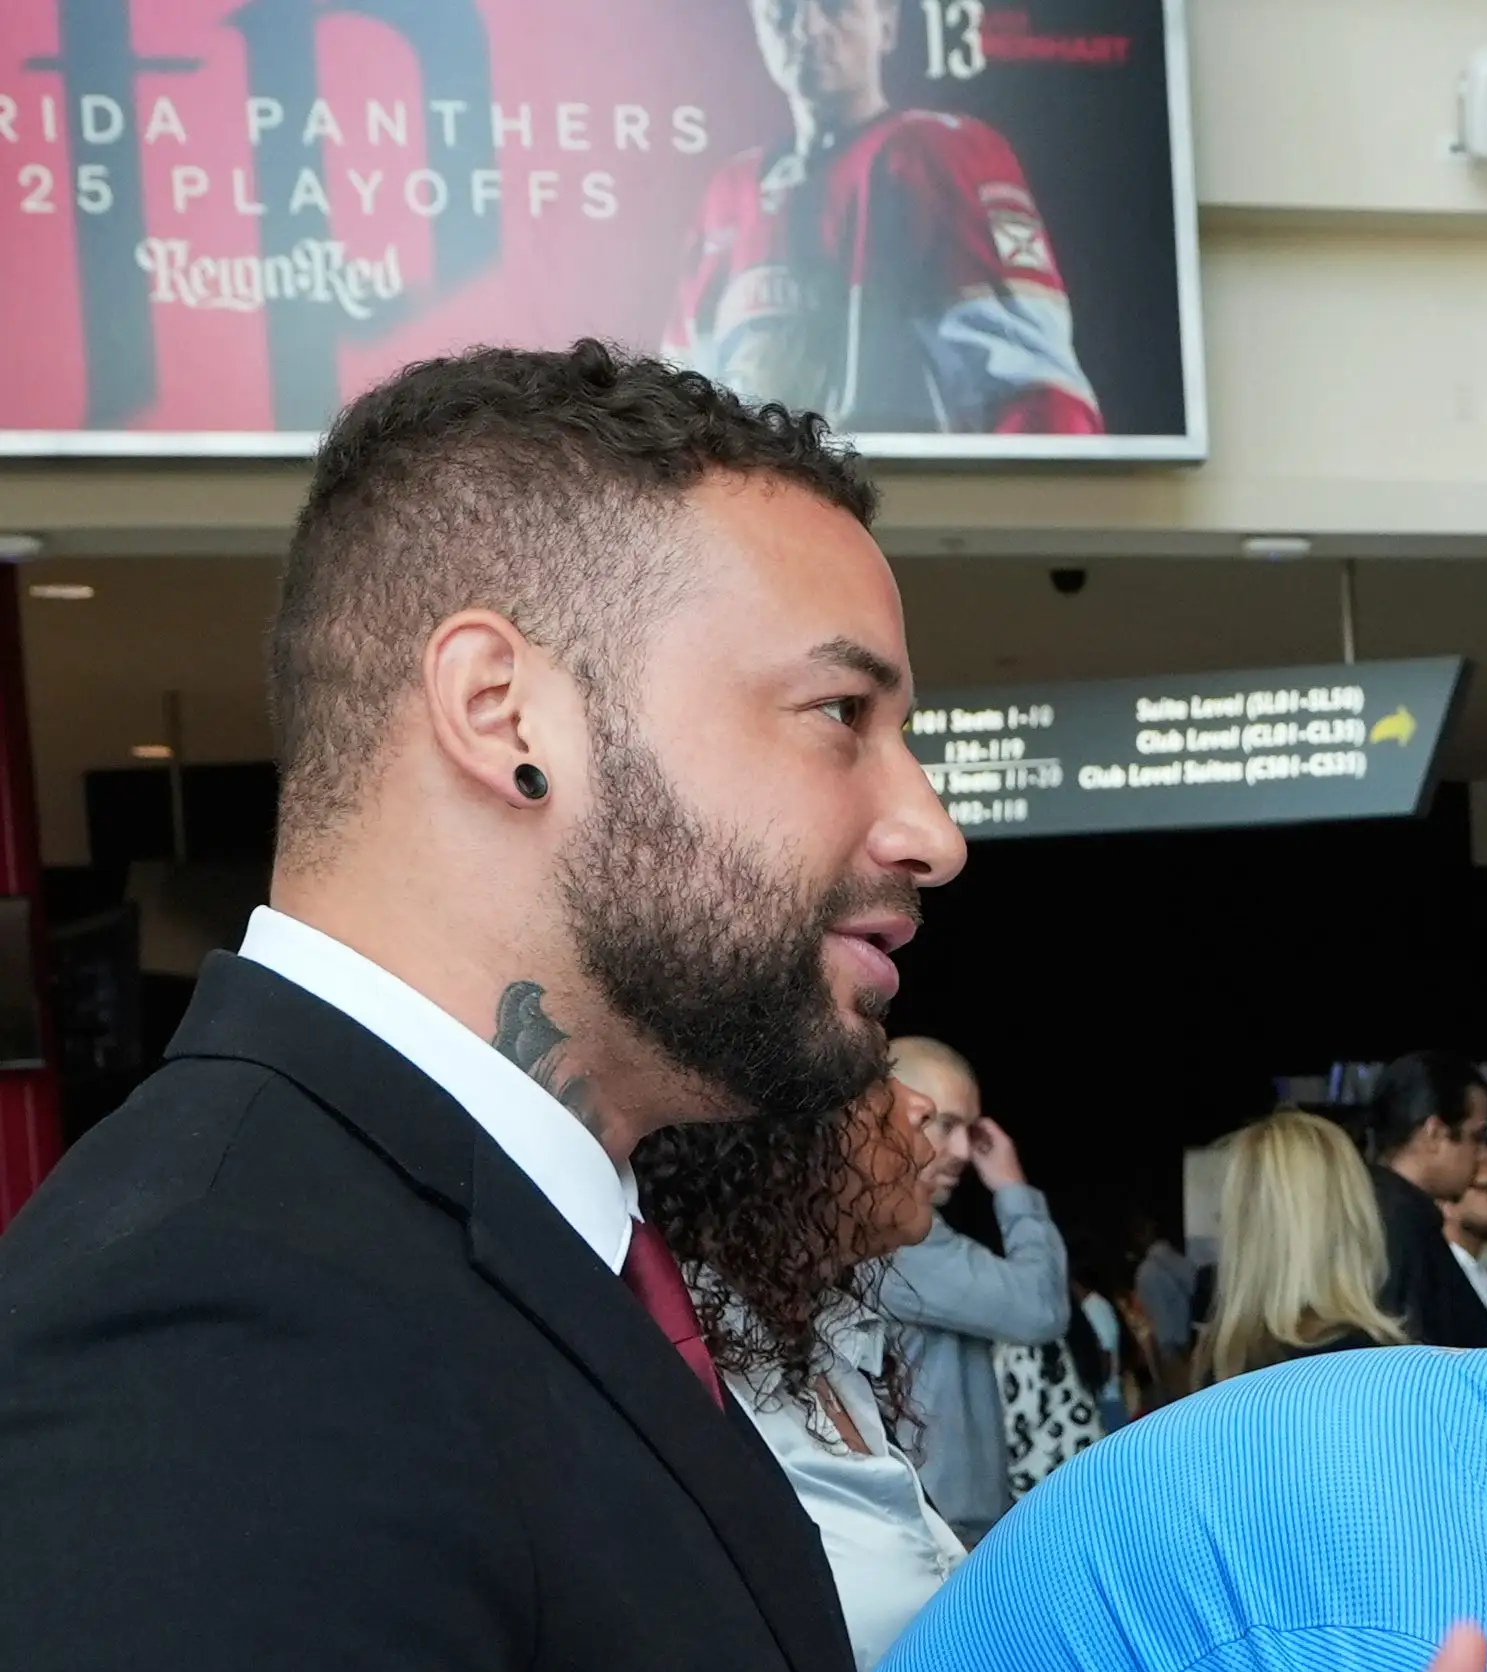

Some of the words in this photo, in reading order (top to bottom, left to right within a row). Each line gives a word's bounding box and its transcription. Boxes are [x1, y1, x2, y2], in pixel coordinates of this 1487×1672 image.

[921, 0, 985, 80] 13
[246, 97, 708, 154] PANTHERS
[172, 165, 618, 219] PLAYOFFS
[950, 708, 1005, 733] Seats
[1136, 697, 1189, 723] Suite
[1190, 692, 1244, 719] Level
[1136, 729, 1184, 755] Club
[1186, 725, 1240, 751] Level
[1078, 764, 1126, 789] Club
[1127, 761, 1182, 786] Level
[1182, 759, 1244, 785] Suites
